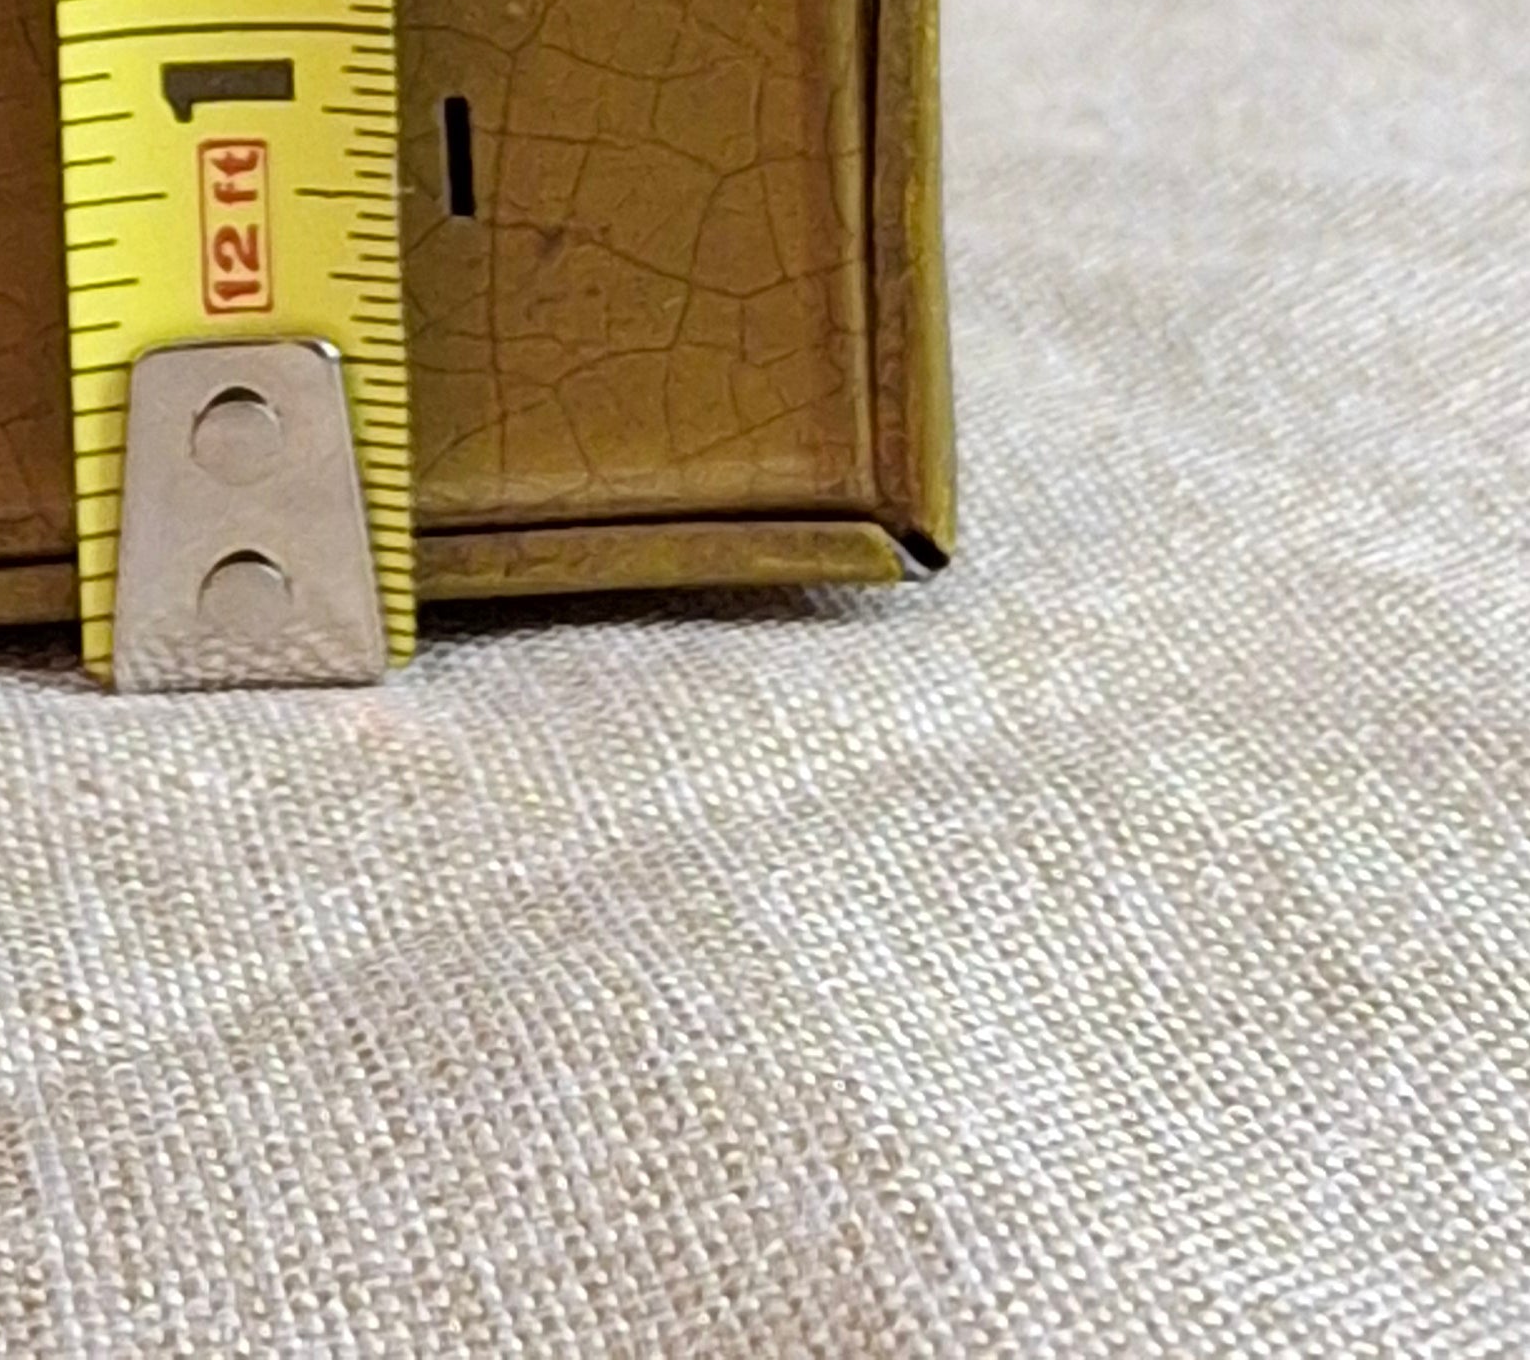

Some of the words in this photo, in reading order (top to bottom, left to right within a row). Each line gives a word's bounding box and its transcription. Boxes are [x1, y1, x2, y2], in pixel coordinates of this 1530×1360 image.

[160, 57, 295, 123] 1
[210, 145, 261, 206] ft
[212, 223, 262, 302] 12
